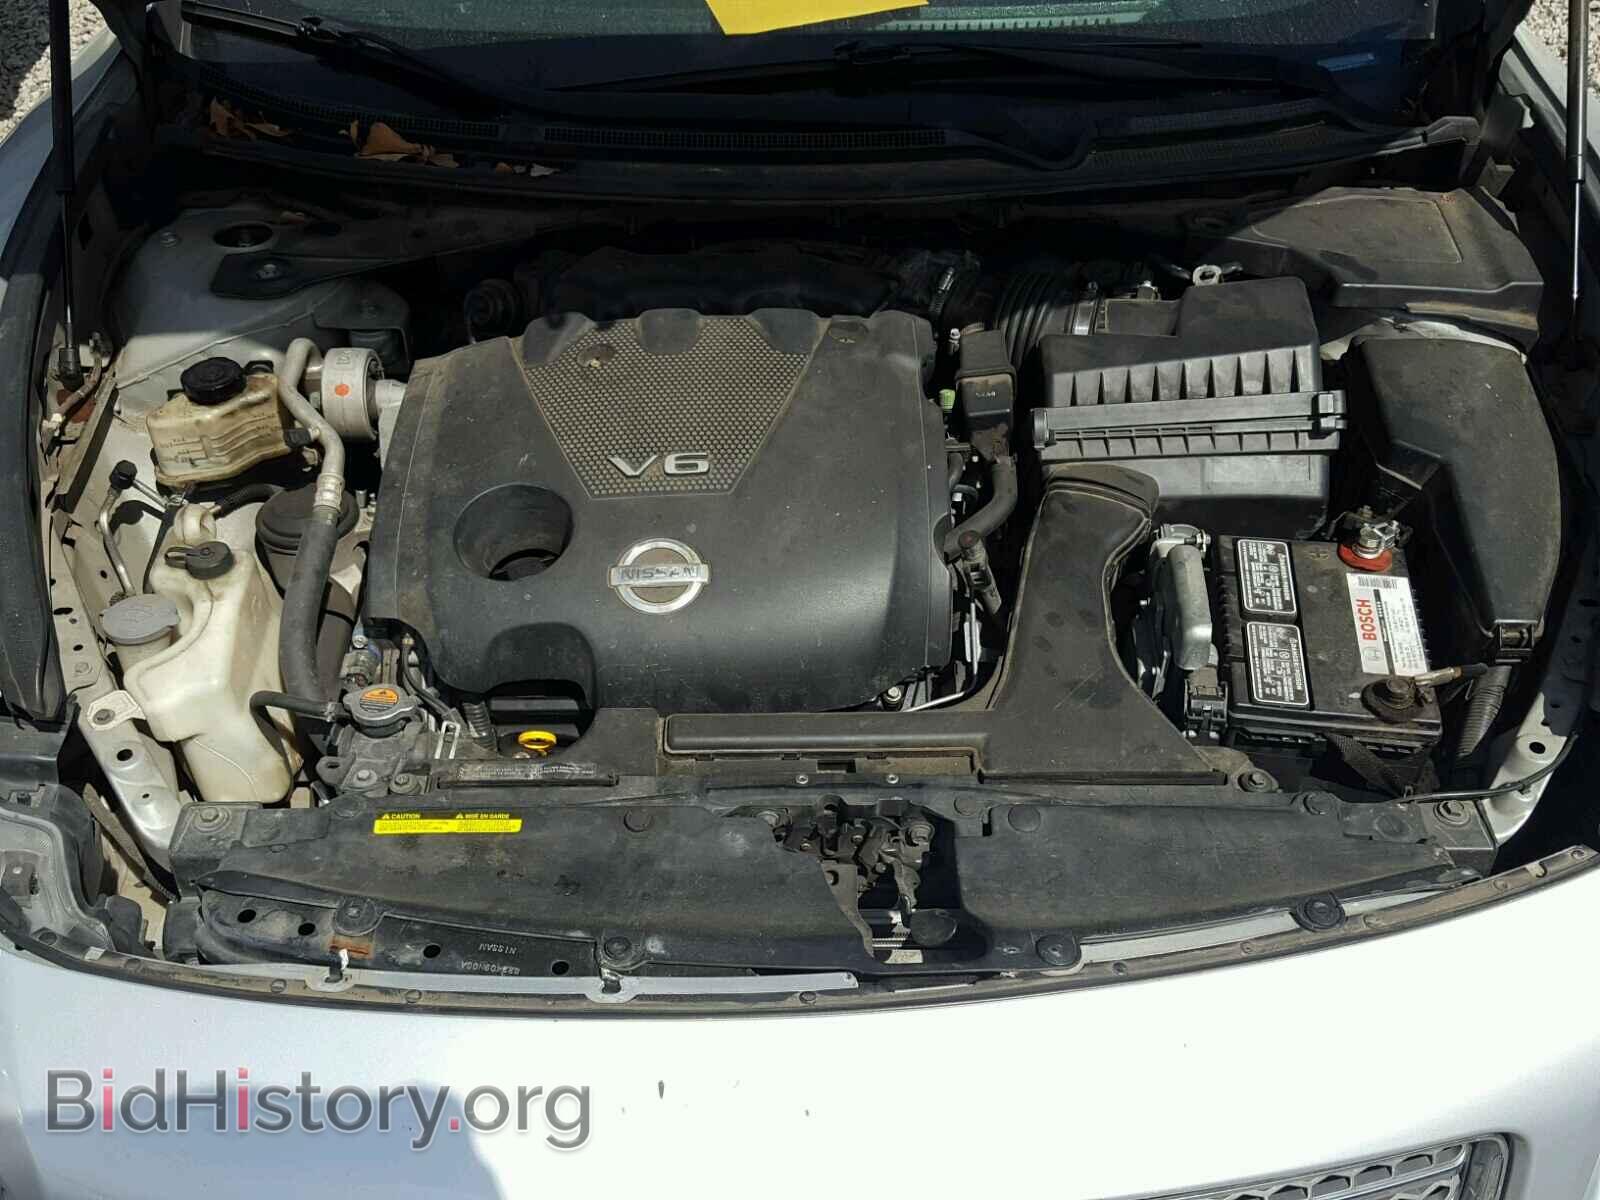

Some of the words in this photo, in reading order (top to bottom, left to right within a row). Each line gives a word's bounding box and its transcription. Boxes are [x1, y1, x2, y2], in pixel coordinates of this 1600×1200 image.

[607, 452, 710, 477] V6
[621, 566, 699, 580] NISSAN
[1356, 599, 1377, 641] BOSCH
[479, 943, 516, 954] NISSAN
